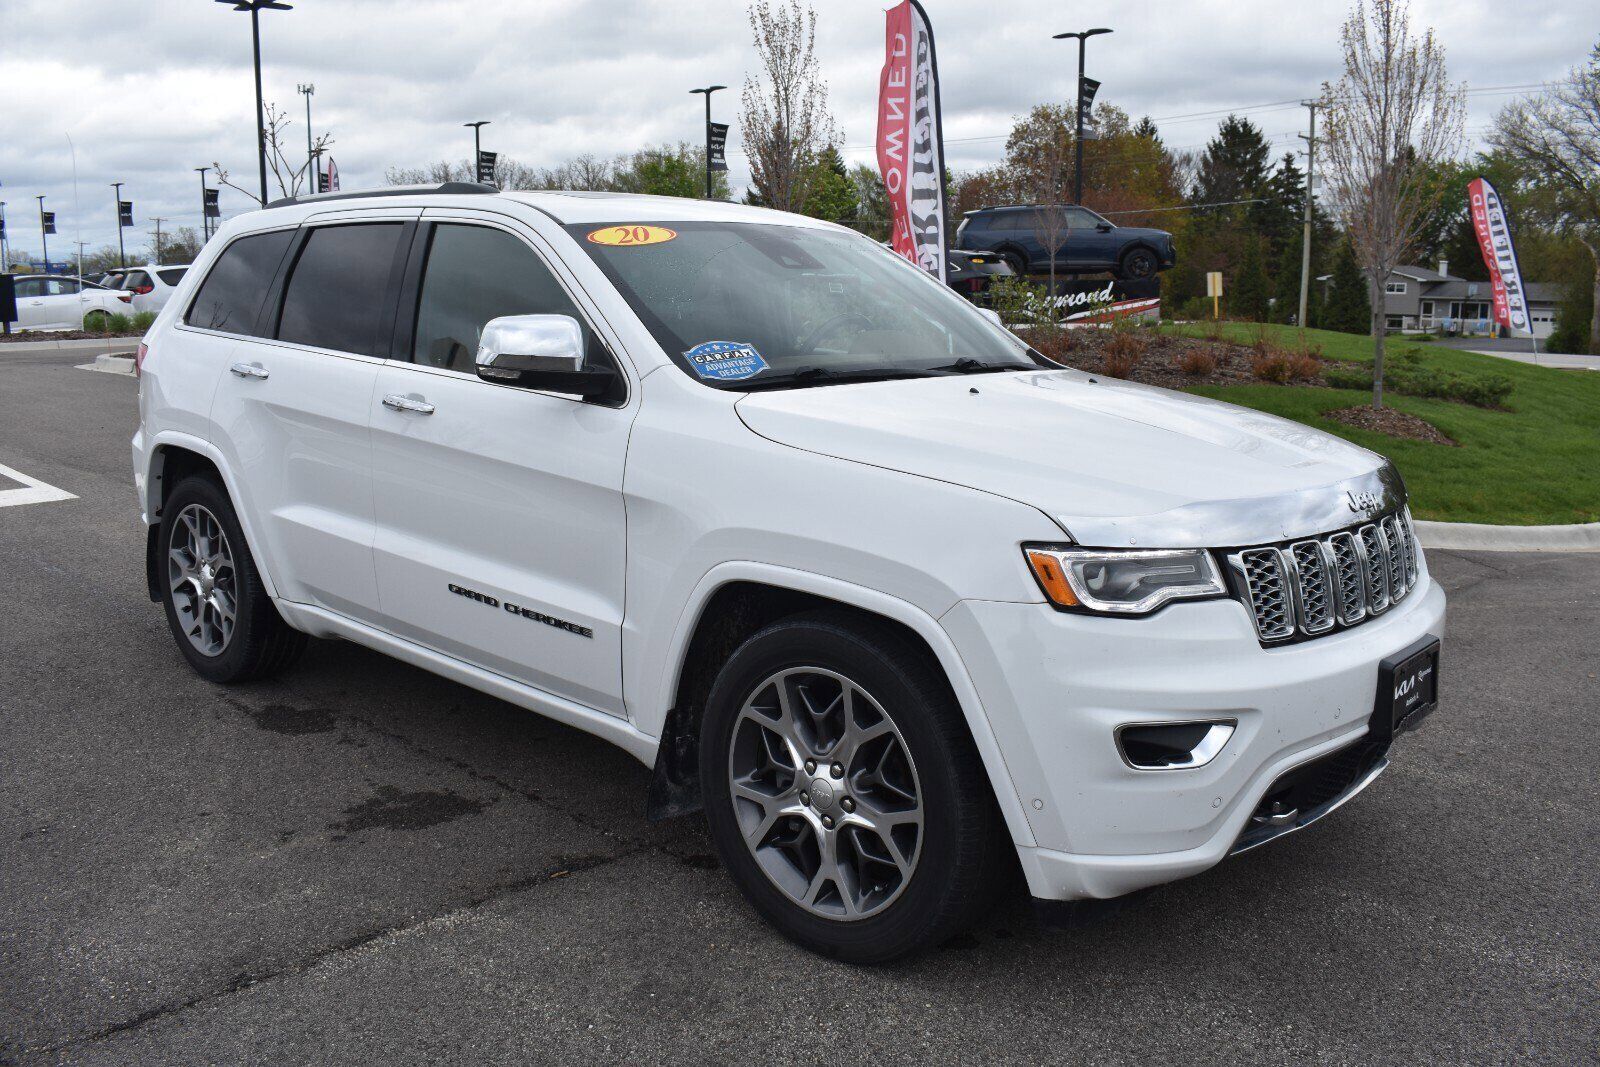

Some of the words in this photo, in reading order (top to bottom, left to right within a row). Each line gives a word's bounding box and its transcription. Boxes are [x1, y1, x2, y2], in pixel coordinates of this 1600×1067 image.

[614, 226, 650, 244] 20
[693, 348, 755, 363] CARFAX
[705, 357, 757, 371] ADVANTAGE
[718, 367, 754, 378] DEALER
[1347, 490, 1378, 514] Jeep
[448, 583, 500, 608] GRAND
[504, 602, 594, 639] CHEROKEE
